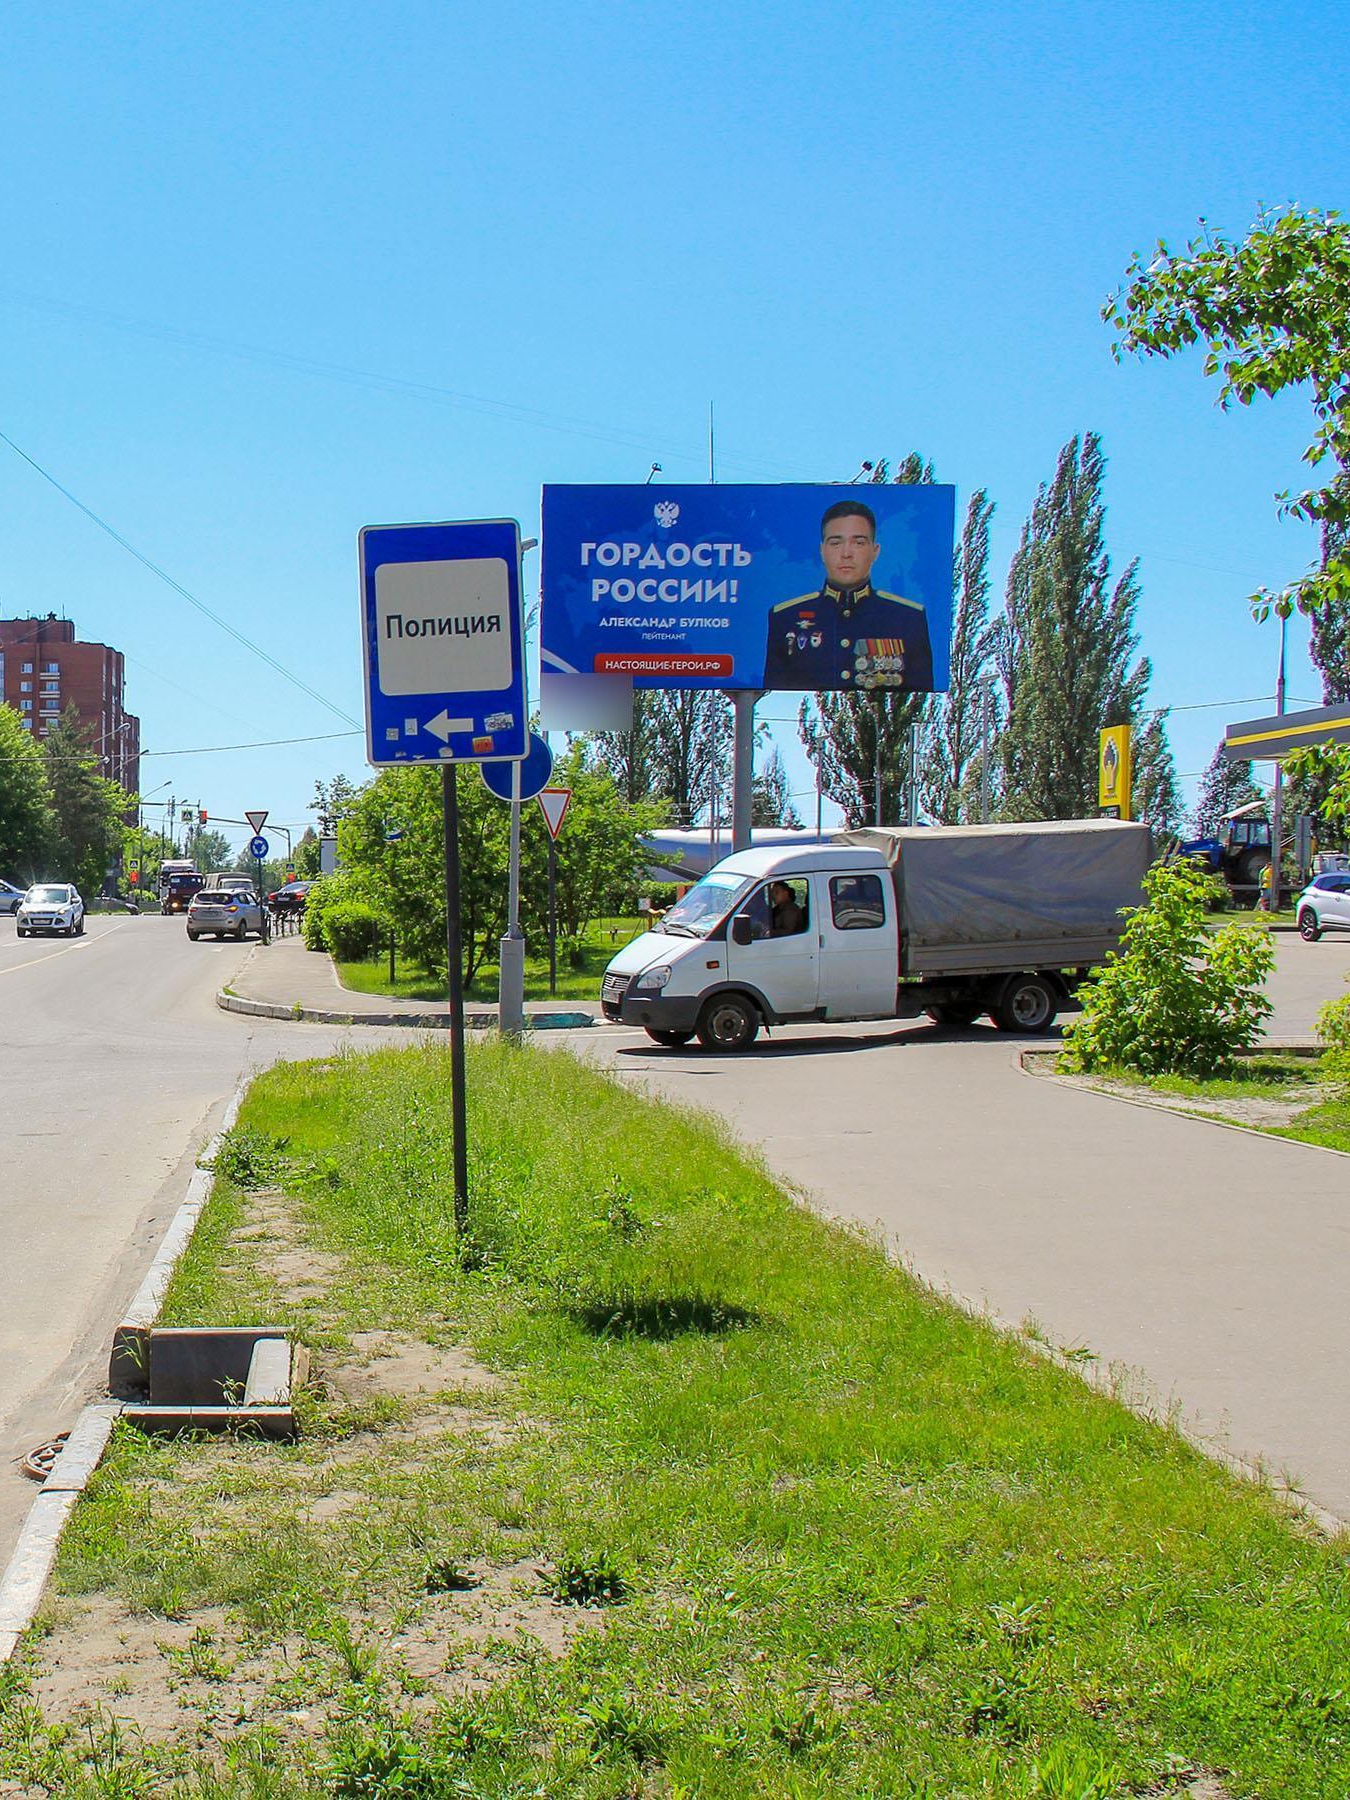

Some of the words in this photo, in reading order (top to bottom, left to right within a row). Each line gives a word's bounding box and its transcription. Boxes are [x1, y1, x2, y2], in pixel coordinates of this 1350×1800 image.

[580, 542, 752, 570] ГОРДОСТЬ
[591, 578, 739, 604] РОССИИ!
[385, 614, 502, 639] Полиция
[599, 617, 677, 629] АЛЕКСАНДР
[679, 617, 731, 628] БУЛКОВ
[604, 659, 722, 671] НАСТОЯЩИЕ-ГЕРОИ.РФ
